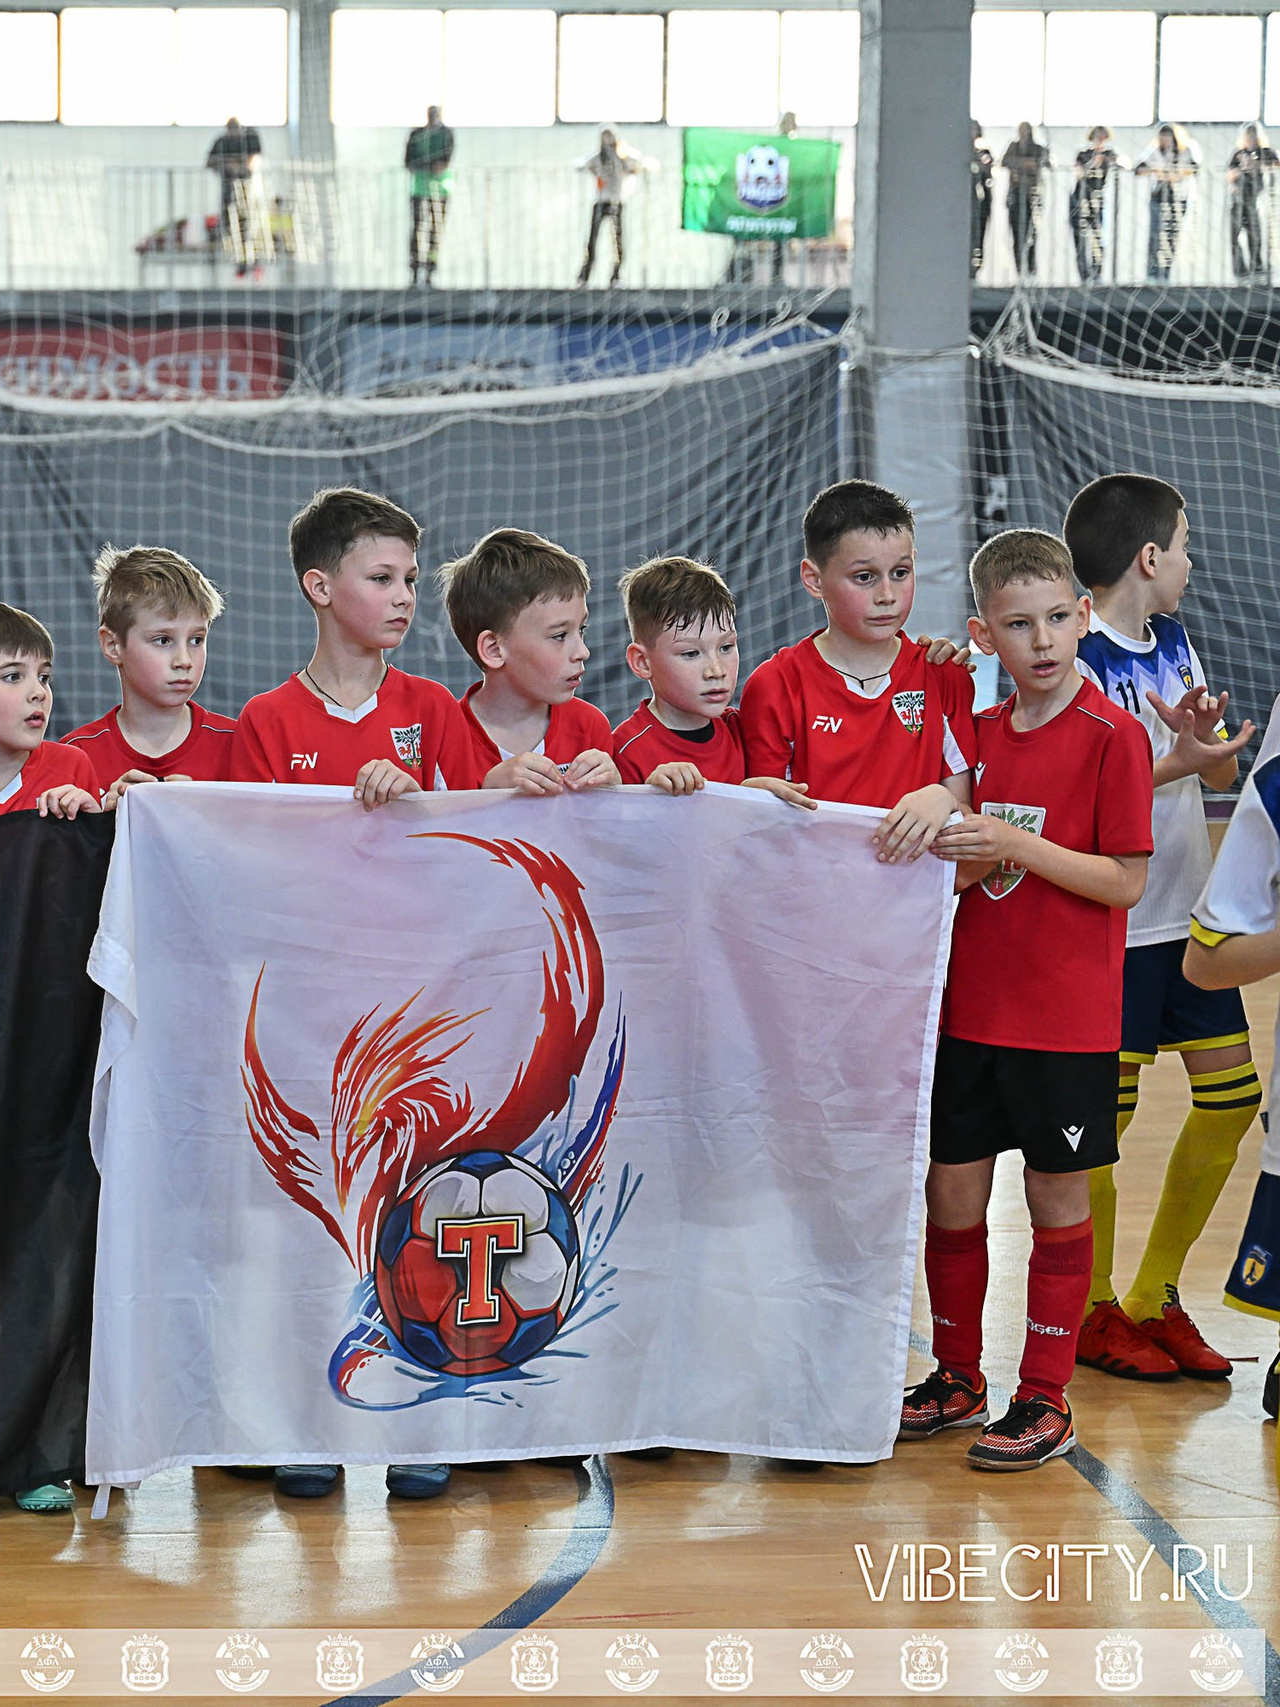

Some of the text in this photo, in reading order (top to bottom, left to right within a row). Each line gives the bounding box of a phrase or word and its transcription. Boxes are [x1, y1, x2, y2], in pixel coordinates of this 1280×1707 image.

[1115, 678, 1141, 715] 11
[811, 714, 843, 734] FN
[290, 751, 319, 771] FN
